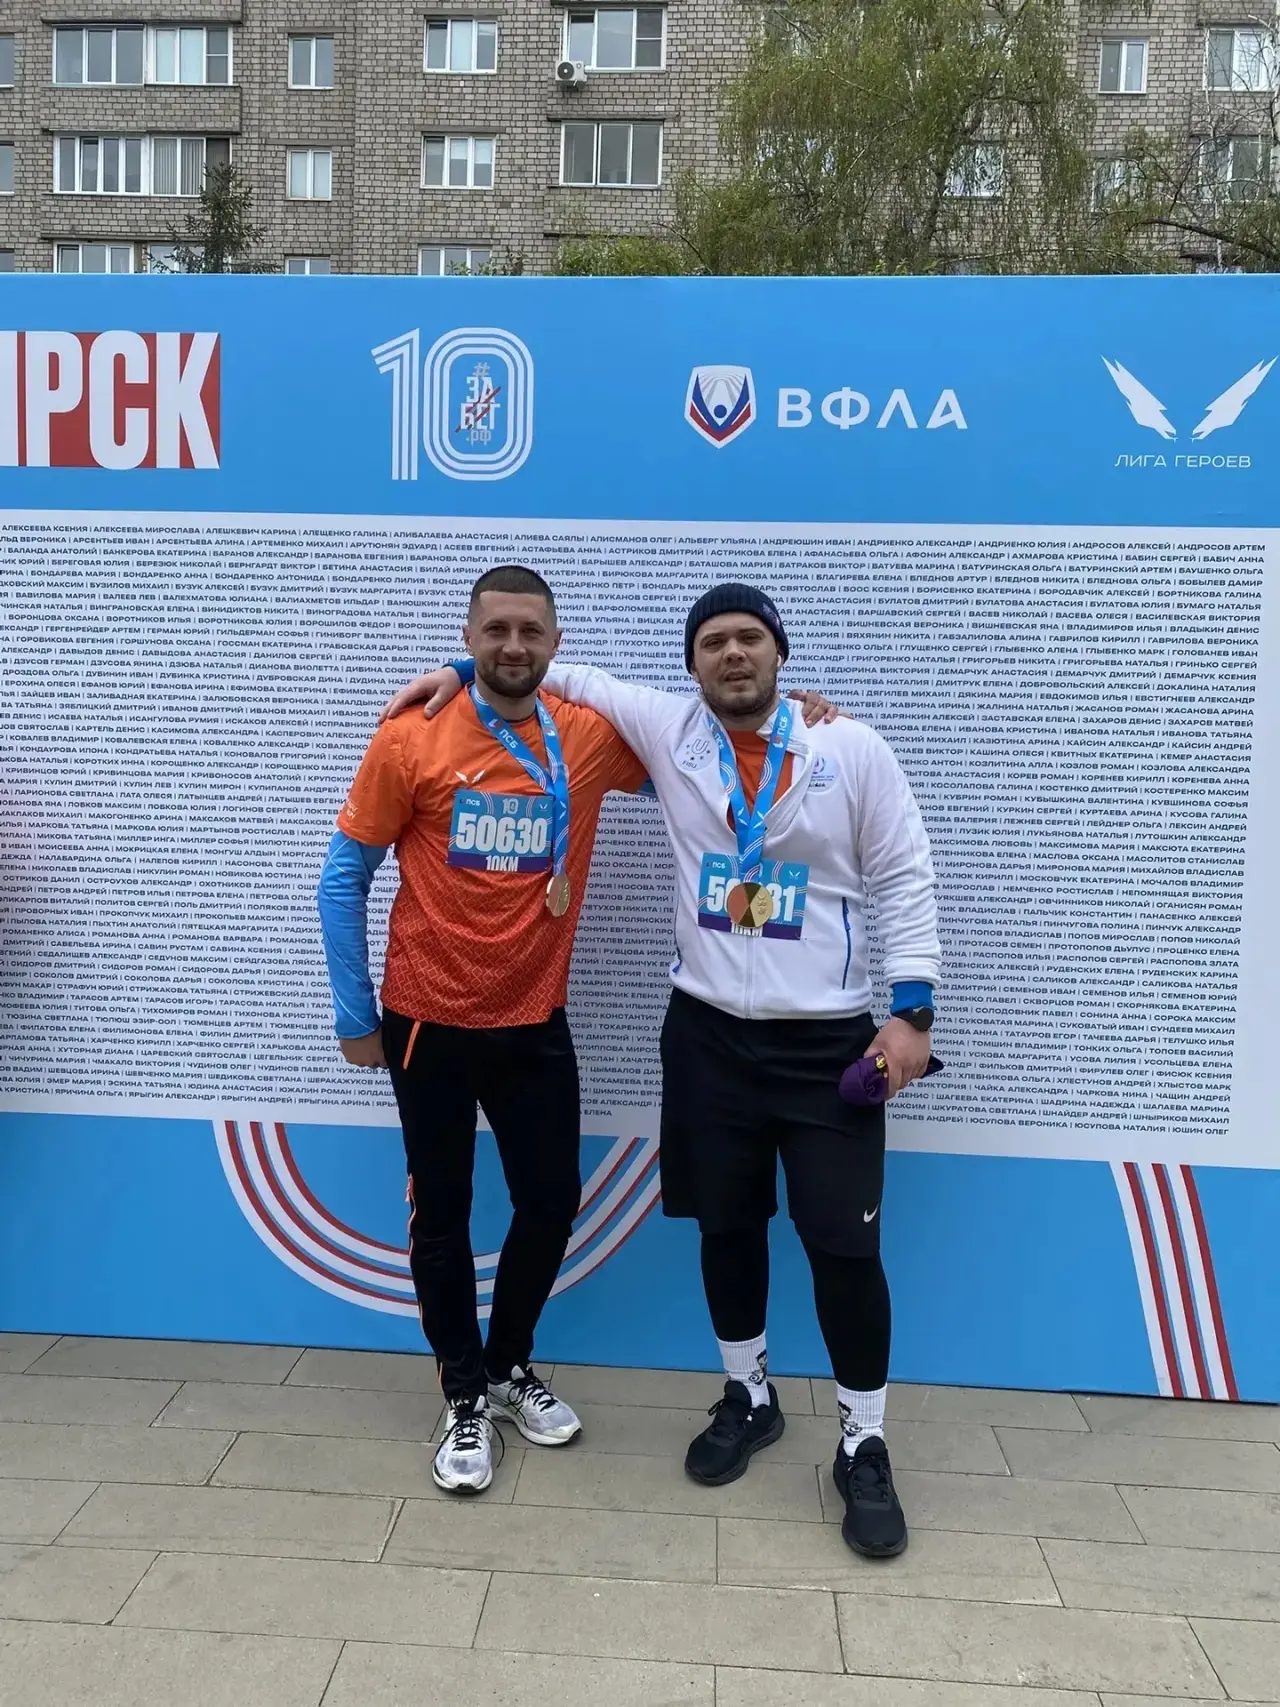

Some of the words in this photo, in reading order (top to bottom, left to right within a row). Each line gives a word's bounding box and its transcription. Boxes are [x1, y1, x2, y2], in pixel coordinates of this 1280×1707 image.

[465, 376, 497, 403] ЗА
[371, 327, 534, 481] 10
[777, 386, 968, 430] ВФЛА
[1114, 454, 1168, 468] ЛИГА
[1174, 454, 1252, 469] ГЕРОЕВ
[937, 632, 1006, 641] ГАБЗАЛИЛОВА
[1048, 634, 1099, 642] ГАВРИЛОВ
[1147, 636, 1204, 644] ГАВРИЛОВА
[498, 728, 518, 749] ПСБ
[873, 723, 919, 731] ИВАНОВА
[958, 725, 1004, 733] ИВАНОВА
[1006, 726, 1057, 734] КРИСТИНА
[1161, 729, 1207, 737] ИВАНОВА
[14, 788, 67, 796] ЛАРИОНОВА
[68, 790, 114, 798] СВЕТЛАНА
[1086, 819, 1130, 827] ЛЕЙДНЕР
[456, 812, 548, 854] 50630
[1, 874, 49, 882] ОСТРИКОВ
[86, 876, 138, 885] ОСТРОУХОВ
[140, 878, 192, 886] АЛЕКСАНДР
[198, 880, 252, 888] ОХОТНИКОВ
[624, 894, 669, 902] ДМИТРИЙ
[958, 906, 1016, 914] ВЛАДИСЛАВ
[1023, 908, 1067, 916] ПАЛЬЧИК
[1069, 909, 1132, 918] КОНСТАНТИН
[1139, 912, 1196, 920] ПАНАСЕНКО
[1198, 914, 1241, 922] АЛЕКСЕЙ
[8, 960, 52, 968] СИДОРОВ
[53, 961, 95, 969] ДМИТРИЙ
[101, 963, 143, 971] СИДОРОВ
[181, 965, 230, 974] СИДОРОВА
[933, 994, 984, 1002] СИМЧЕНКО
[985, 996, 1016, 1004] ПАВЕЛ
[1022, 997, 1074, 1006] СКВОРЦОВ
[1116, 1001, 1180, 1010] СКОРНЯКОВА
[1182, 1003, 1236, 1012] ЕКАТЕРИНА
[57, 1046, 102, 1054] ХУТОРНАЯ
[104, 1047, 134, 1056] ДИАНА
[140, 1049, 192, 1057] ЦАРЕВСКИЙ
[194, 1050, 247, 1059] СВЯТОСЛАВ
[253, 1053, 304, 1062] ЦЕГЕЛЬНИК
[305, 1054, 338, 1063] СЕРГЕЙ
[4, 1085, 49, 1094] КРИСТИНА
[54, 1087, 95, 1095] ЯРИЧИНА
[164, 1092, 215, 1100] АЛЕКСАНДР
[220, 1094, 256, 1102] ЯРЫГИН
[257, 1095, 292, 1104] АНДРЕЙ
[298, 1097, 339, 1105] ЯРЫГИНА
[916, 1081, 966, 1089] ВИКТОРИЯ
[974, 1084, 1006, 1092] ЧАЙКА
[1006, 1085, 1068, 1095] АЛЕКСАНДРА
[1076, 1088, 1119, 1097] ЧАРКОВА
[1155, 1092, 1190, 1100] ЧАЩИН
[1191, 1093, 1230, 1102] АНДРЕЙ
[926, 1114, 963, 1123] АНДРЕЙ
[969, 1116, 1016, 1125] ЮСУПОВА
[1017, 1119, 1067, 1127] ВЕРОНИКА
[1074, 1121, 1120, 1130] ЮСУПОВА
[1122, 1124, 1166, 1132] НАТАЛИЯ
